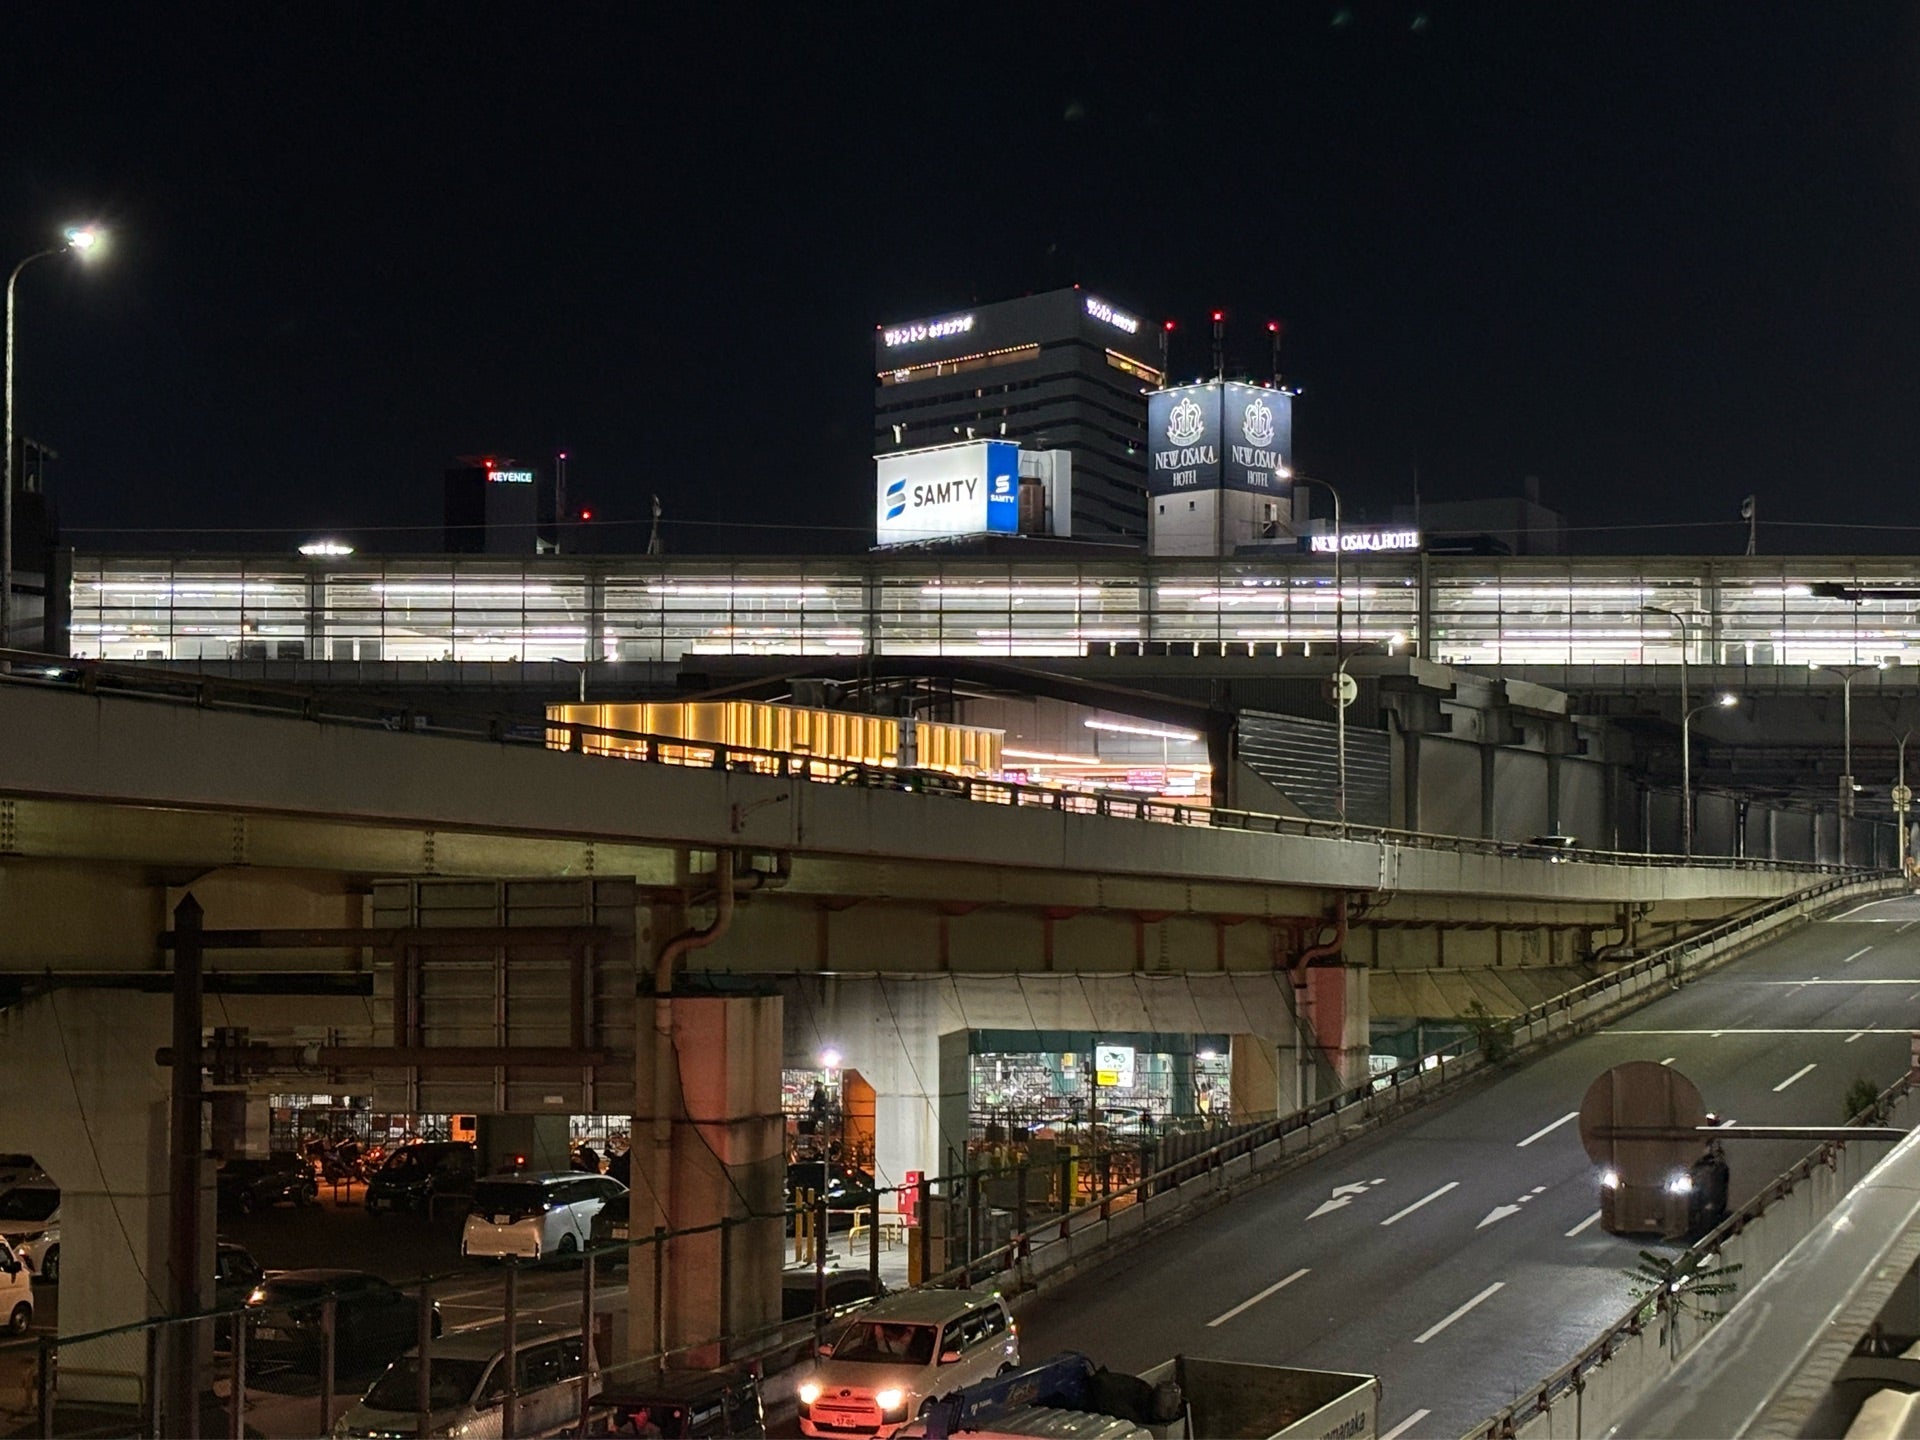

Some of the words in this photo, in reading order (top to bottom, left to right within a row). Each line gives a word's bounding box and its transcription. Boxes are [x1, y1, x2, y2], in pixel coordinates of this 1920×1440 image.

[884, 324, 927, 347] ワシントン
[1155, 450, 1182, 470] NEW
[1181, 445, 1218, 467] OSAKA
[1232, 445, 1255, 467] NEW
[1254, 449, 1284, 470] OSAKA
[488, 472, 532, 483] KEYENCE
[1172, 469, 1197, 487] HOTEL
[1247, 470, 1269, 488] HOTEL
[914, 477, 978, 508] SAMTY
[990, 494, 1015, 503] SAMTY
[1311, 536, 1339, 552] NEW
[1341, 533, 1381, 551] OSAKA
[1381, 532, 1418, 549] HOTEL
